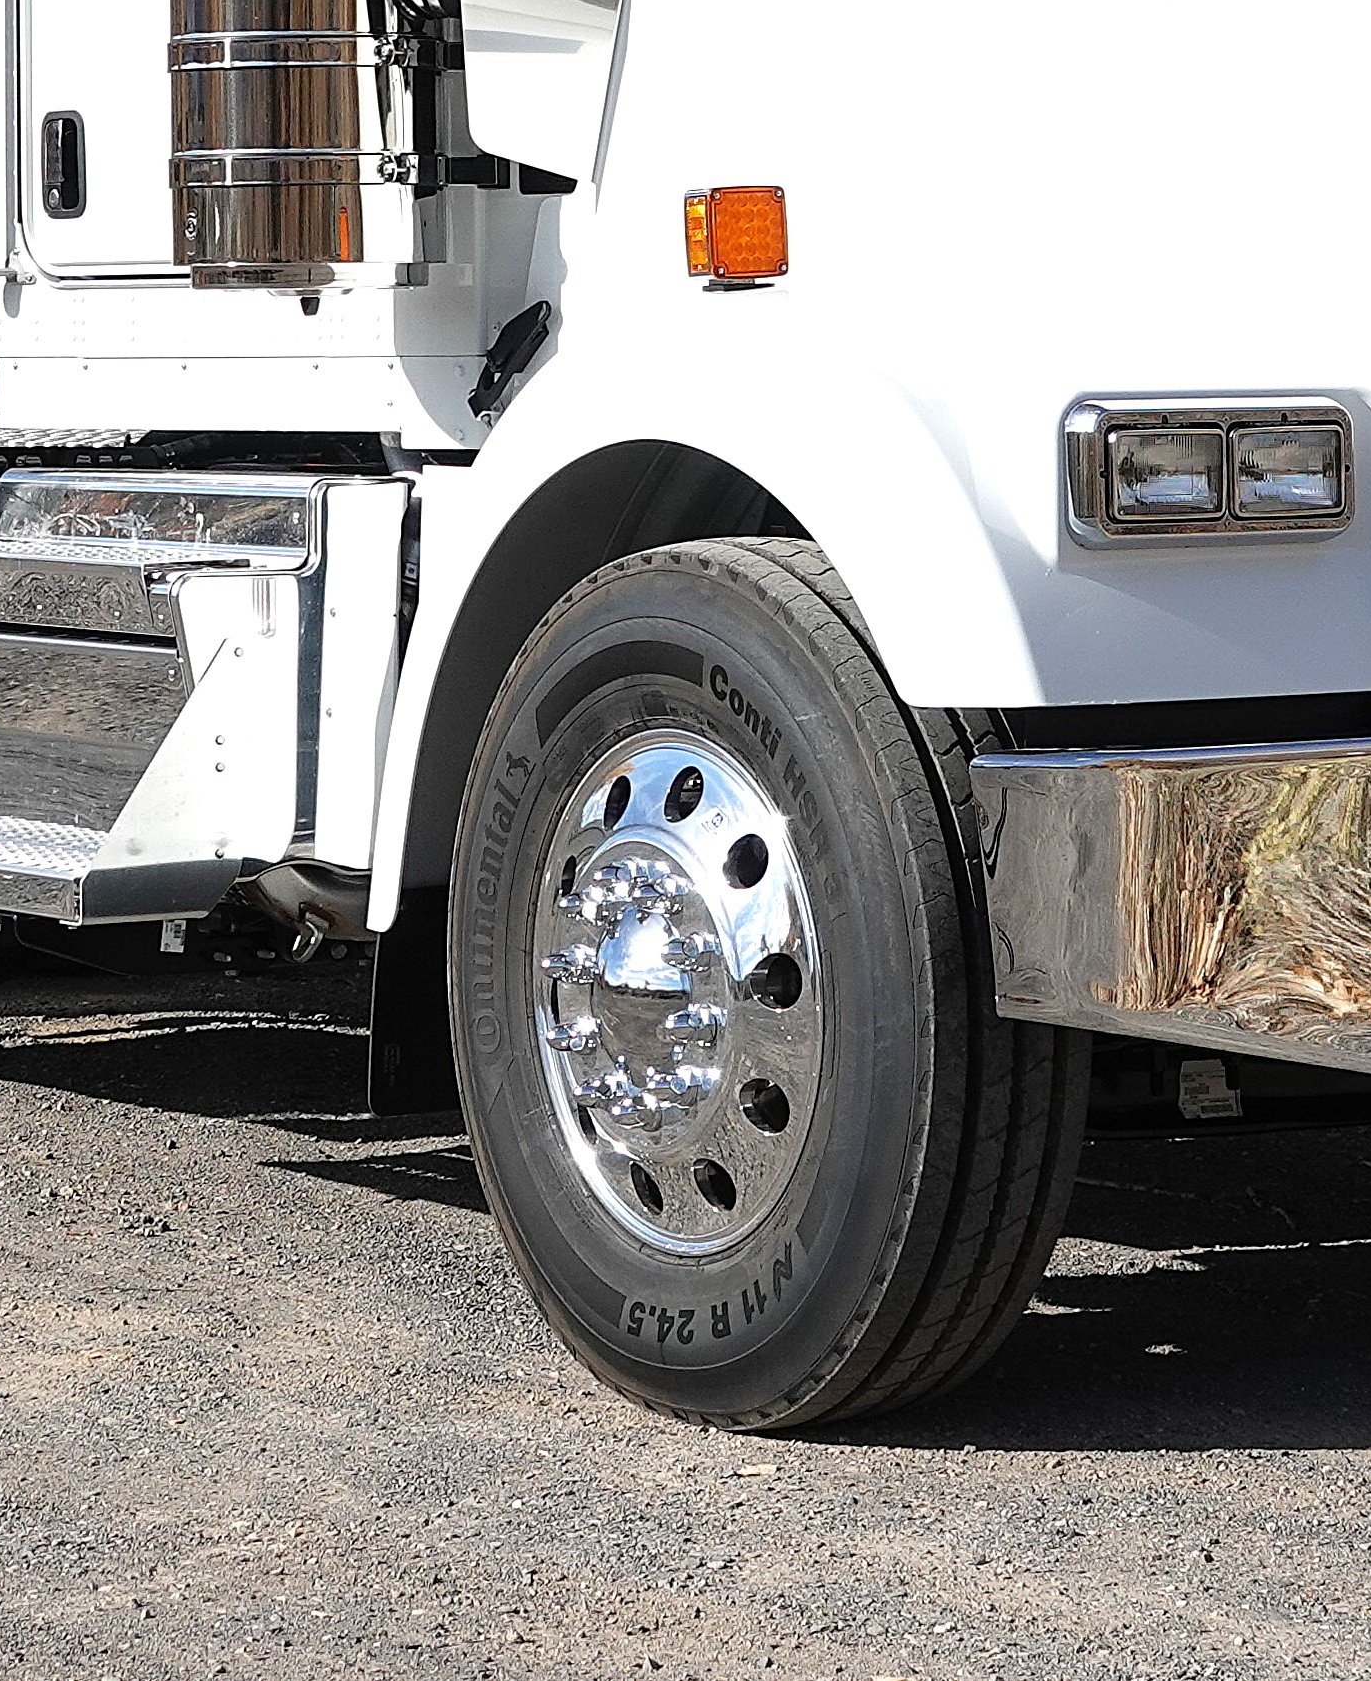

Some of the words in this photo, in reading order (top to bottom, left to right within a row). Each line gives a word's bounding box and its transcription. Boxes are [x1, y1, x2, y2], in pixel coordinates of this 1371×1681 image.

[709, 663, 783, 761] Conti
[626, 1301, 696, 1345] 24.5
[710, 1301, 731, 1339] R
[741, 1278, 768, 1325] 11
